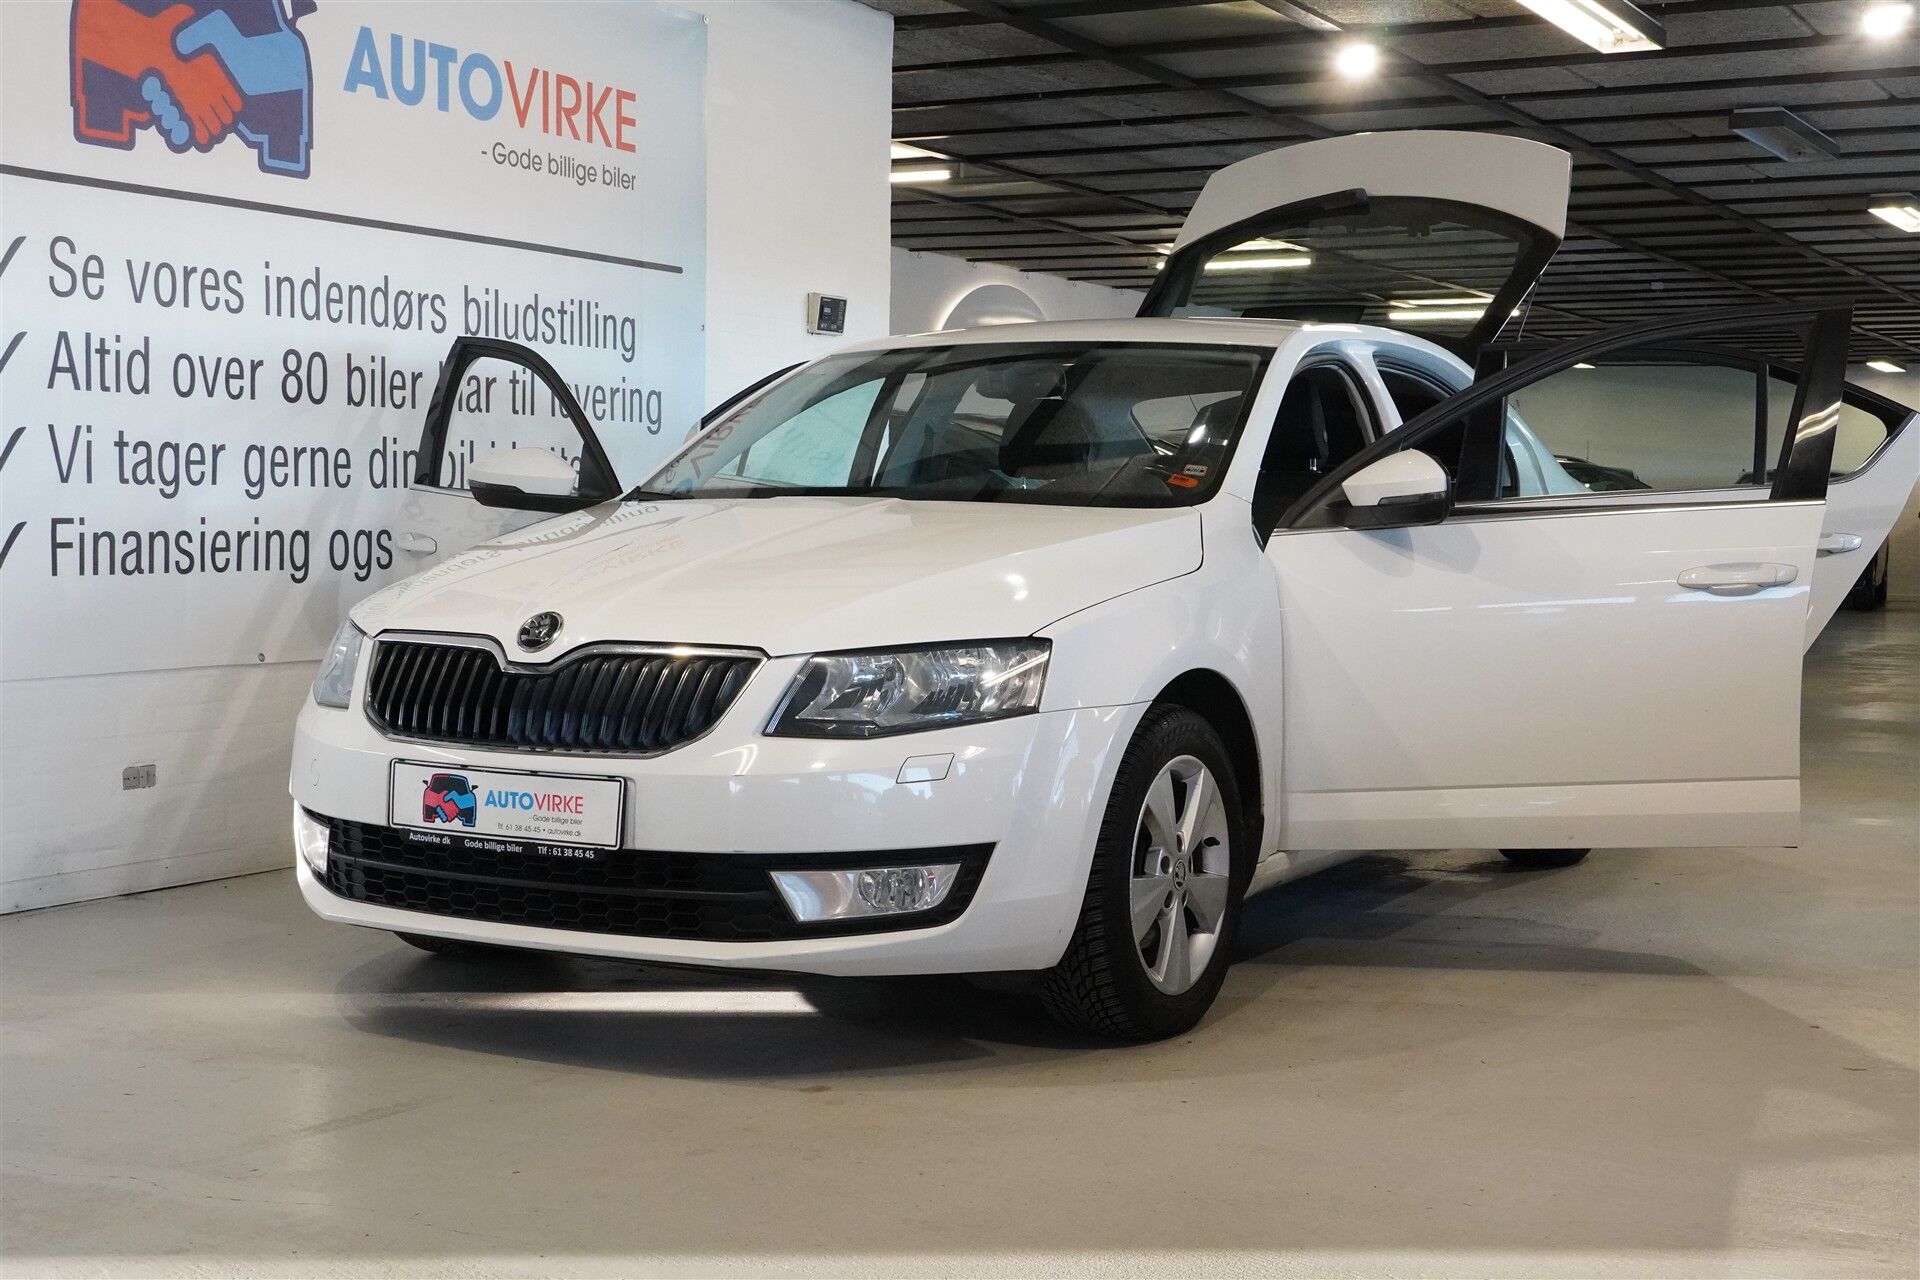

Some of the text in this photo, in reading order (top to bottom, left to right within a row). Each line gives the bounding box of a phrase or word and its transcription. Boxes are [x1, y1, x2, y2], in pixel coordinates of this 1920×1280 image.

[343, 25, 637, 154] AUTOVIRKE
[492, 142, 543, 173] Gode
[548, 153, 598, 187] billige
[602, 163, 637, 191] biler
[48, 235, 636, 364] Se vores indendørs biludstilling
[47, 330, 151, 396] Altid
[172, 352, 265, 401] over
[280, 348, 329, 406] 80
[346, 352, 424, 410] biler
[508, 368, 535, 417] til
[47, 423, 93, 485] Vi
[113, 429, 227, 500] tager
[243, 443, 352, 501] gerne
[50, 516, 310, 585] Finansiering
[485, 789, 583, 814] AUTOVIRKE
[524, 825, 532, 833] 45
[533, 826, 541, 834] 45
[532, 814, 551, 823] Gode
[551, 816, 569, 826] billige
[409, 832, 441, 844] Autovirke
[464, 839, 483, 849] Gode
[484, 841, 506, 852] billige
[506, 843, 523, 853] biler
[537, 846, 548, 855] Tlf
[552, 847, 562, 856] 61
[563, 848, 573, 857] 38
[574, 849, 584, 858] 45
[584, 850, 595, 859] 45
